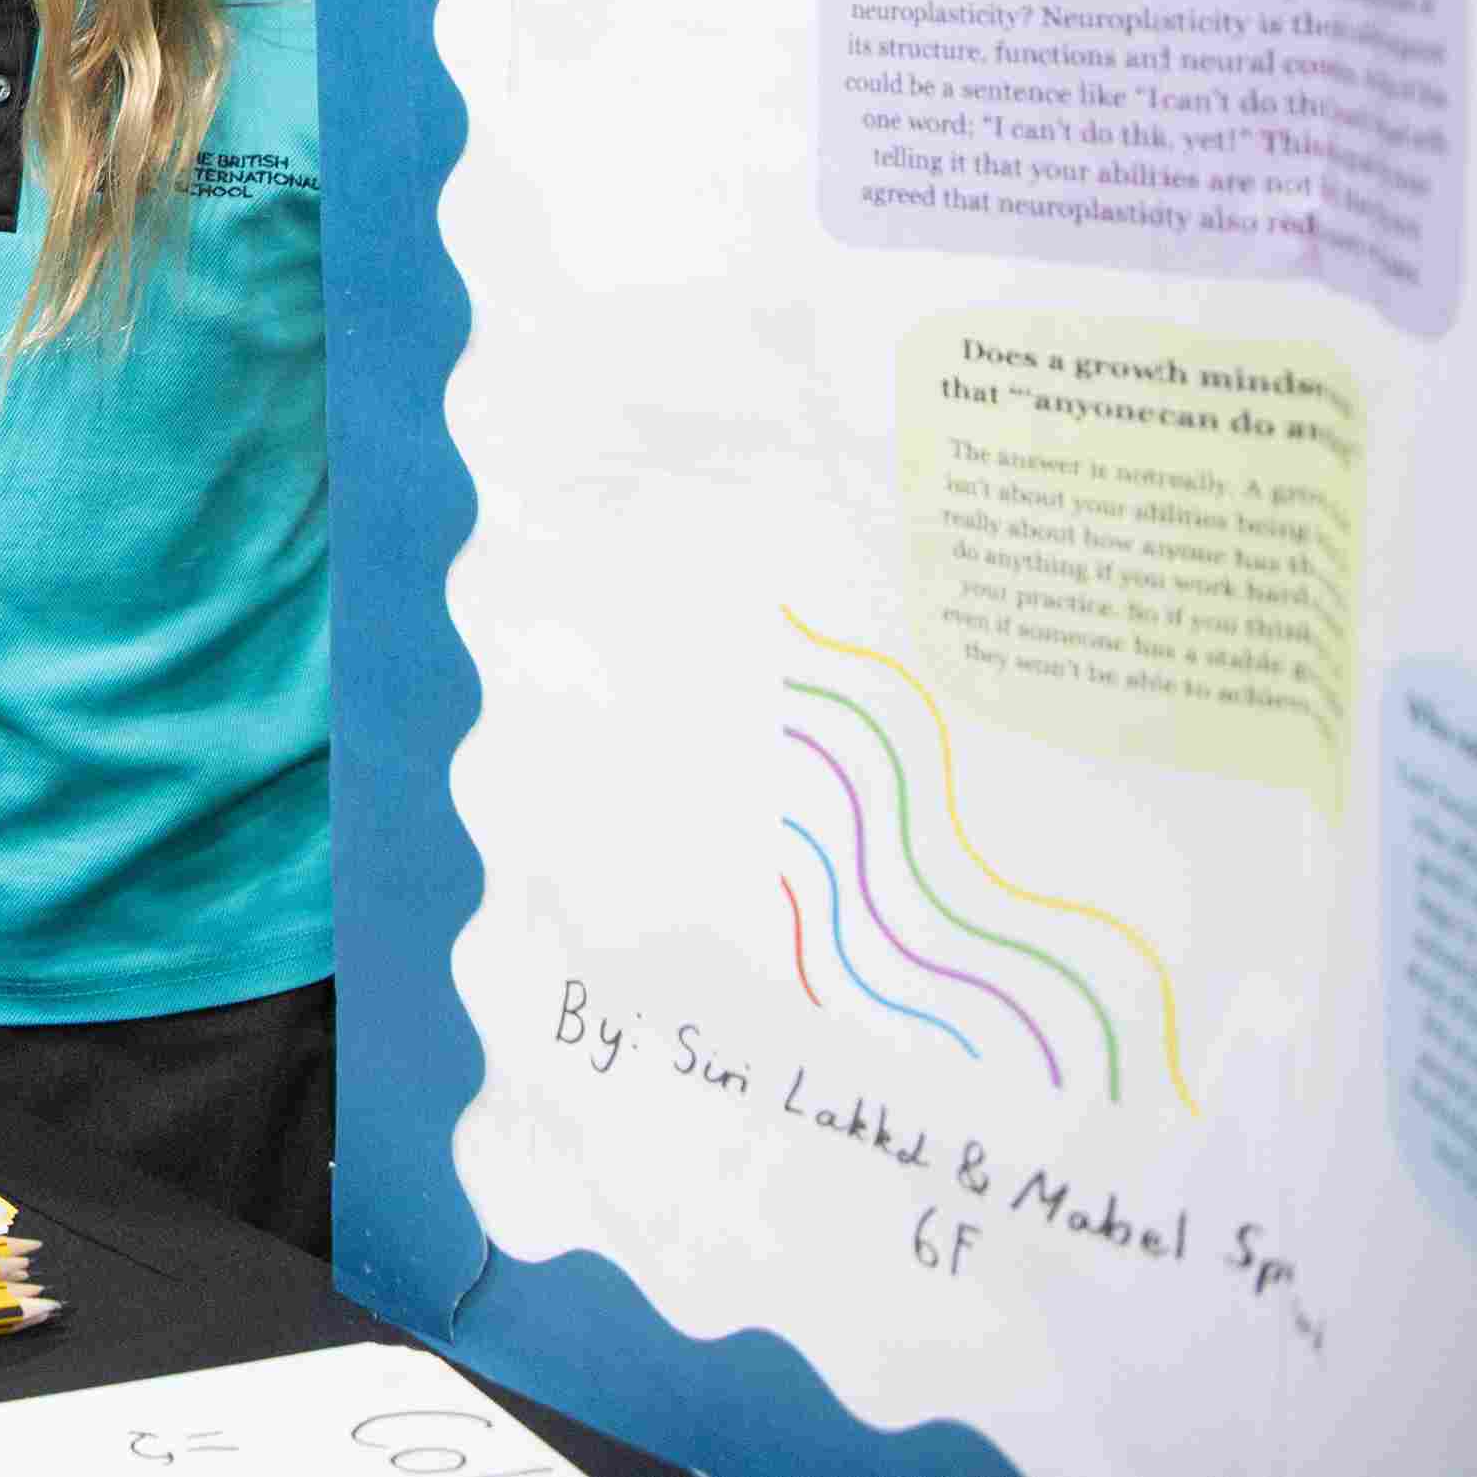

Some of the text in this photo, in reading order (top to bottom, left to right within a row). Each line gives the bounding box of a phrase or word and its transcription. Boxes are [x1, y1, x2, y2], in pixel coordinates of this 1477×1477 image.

[851, 0, 1283, 39] neuroplasticity? Neuroplasticity is
[847, 33, 1275, 75] its structure, functions and neural
[844, 72, 903, 94] could
[910, 73, 935, 97] be
[943, 82, 954, 97] a
[961, 83, 1072, 105] sentence
[1079, 80, 1127, 108] like
[1239, 88, 1278, 114] do
[862, 111, 902, 131] one
[1011, 119, 1072, 141] can't
[1079, 120, 1113, 144] do
[194, 165, 320, 192] TERNATIONAL
[217, 153, 289, 169] BRITISH
[873, 145, 1311, 196] telling it that your abilities are not
[862, 183, 1257, 232] agreed that neuroplasticity also
[963, 338, 1038, 367] Does
[1048, 355, 1064, 370] a
[1074, 358, 1188, 386] growth
[942, 375, 998, 404] that
[1230, 407, 1275, 437] do
[555, 978, 643, 1073] By:
[957, 1140, 990, 1195] &
[1010, 1168, 1188, 1262] Mabel
[914, 1205, 982, 1276] 6F
